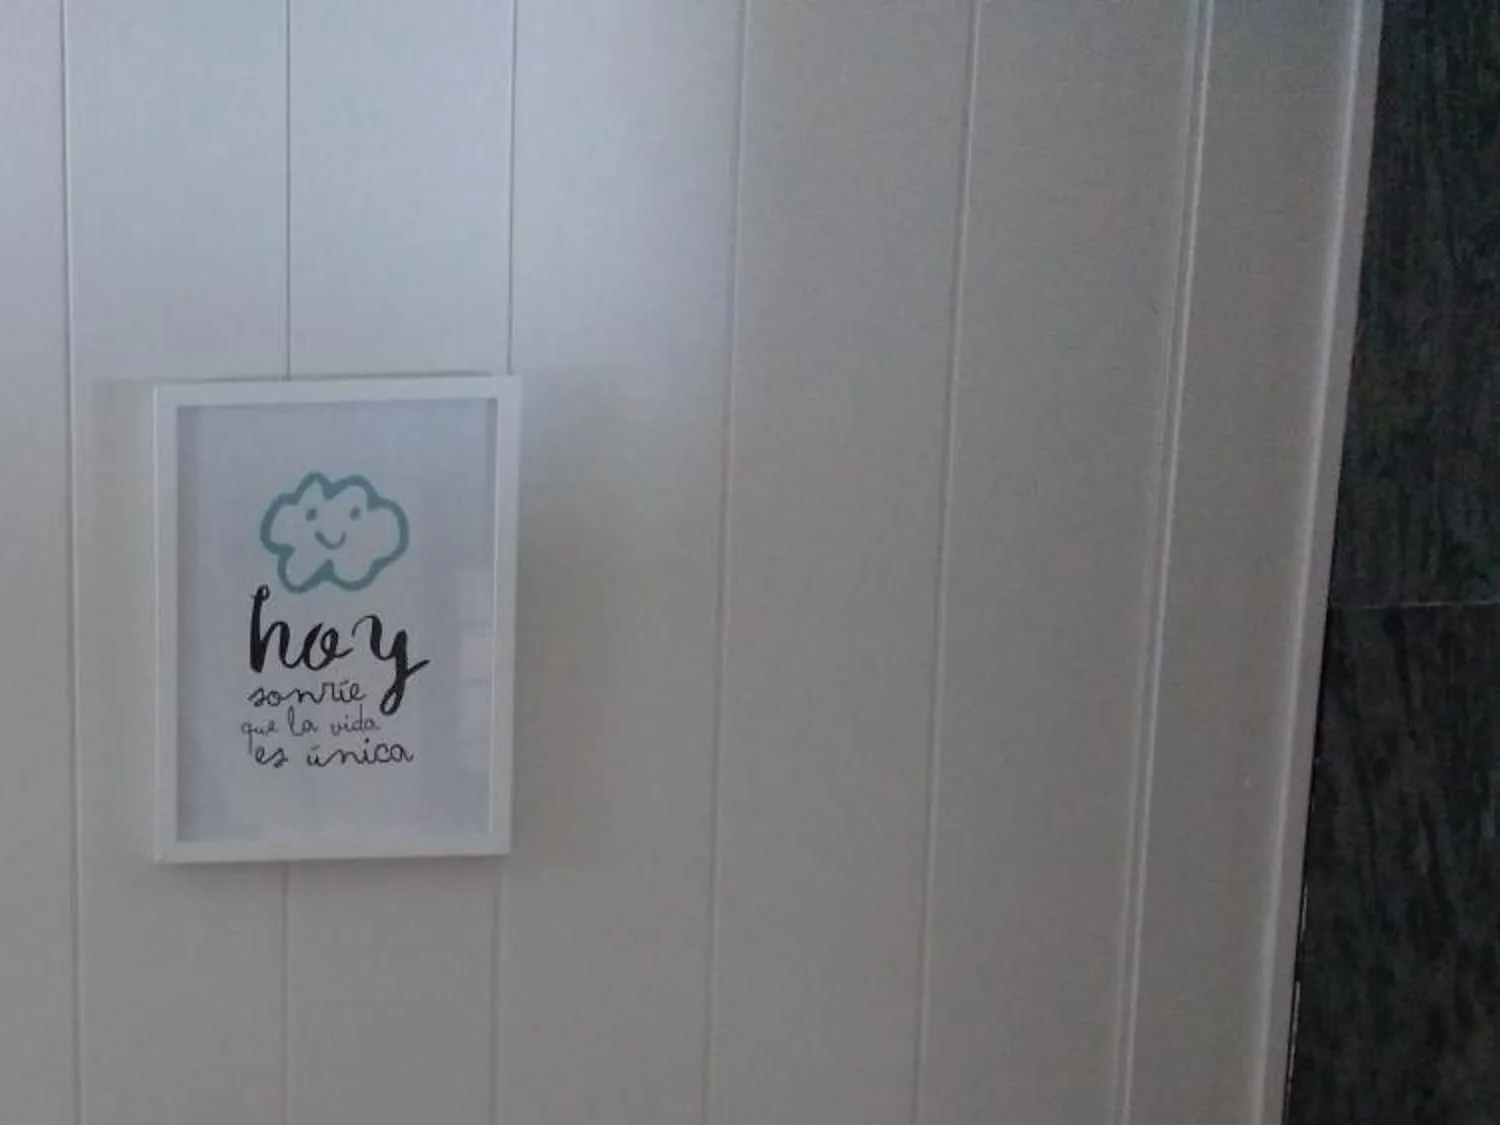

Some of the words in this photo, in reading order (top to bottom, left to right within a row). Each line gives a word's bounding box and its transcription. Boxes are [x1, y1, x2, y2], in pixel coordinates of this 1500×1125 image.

[249, 584, 430, 715] hoy
[248, 680, 368, 707] sonríe
[241, 719, 279, 754] que
[287, 705, 319, 737] la
[330, 703, 381, 736] vida
[255, 746, 289, 768] es
[306, 736, 414, 768] única
